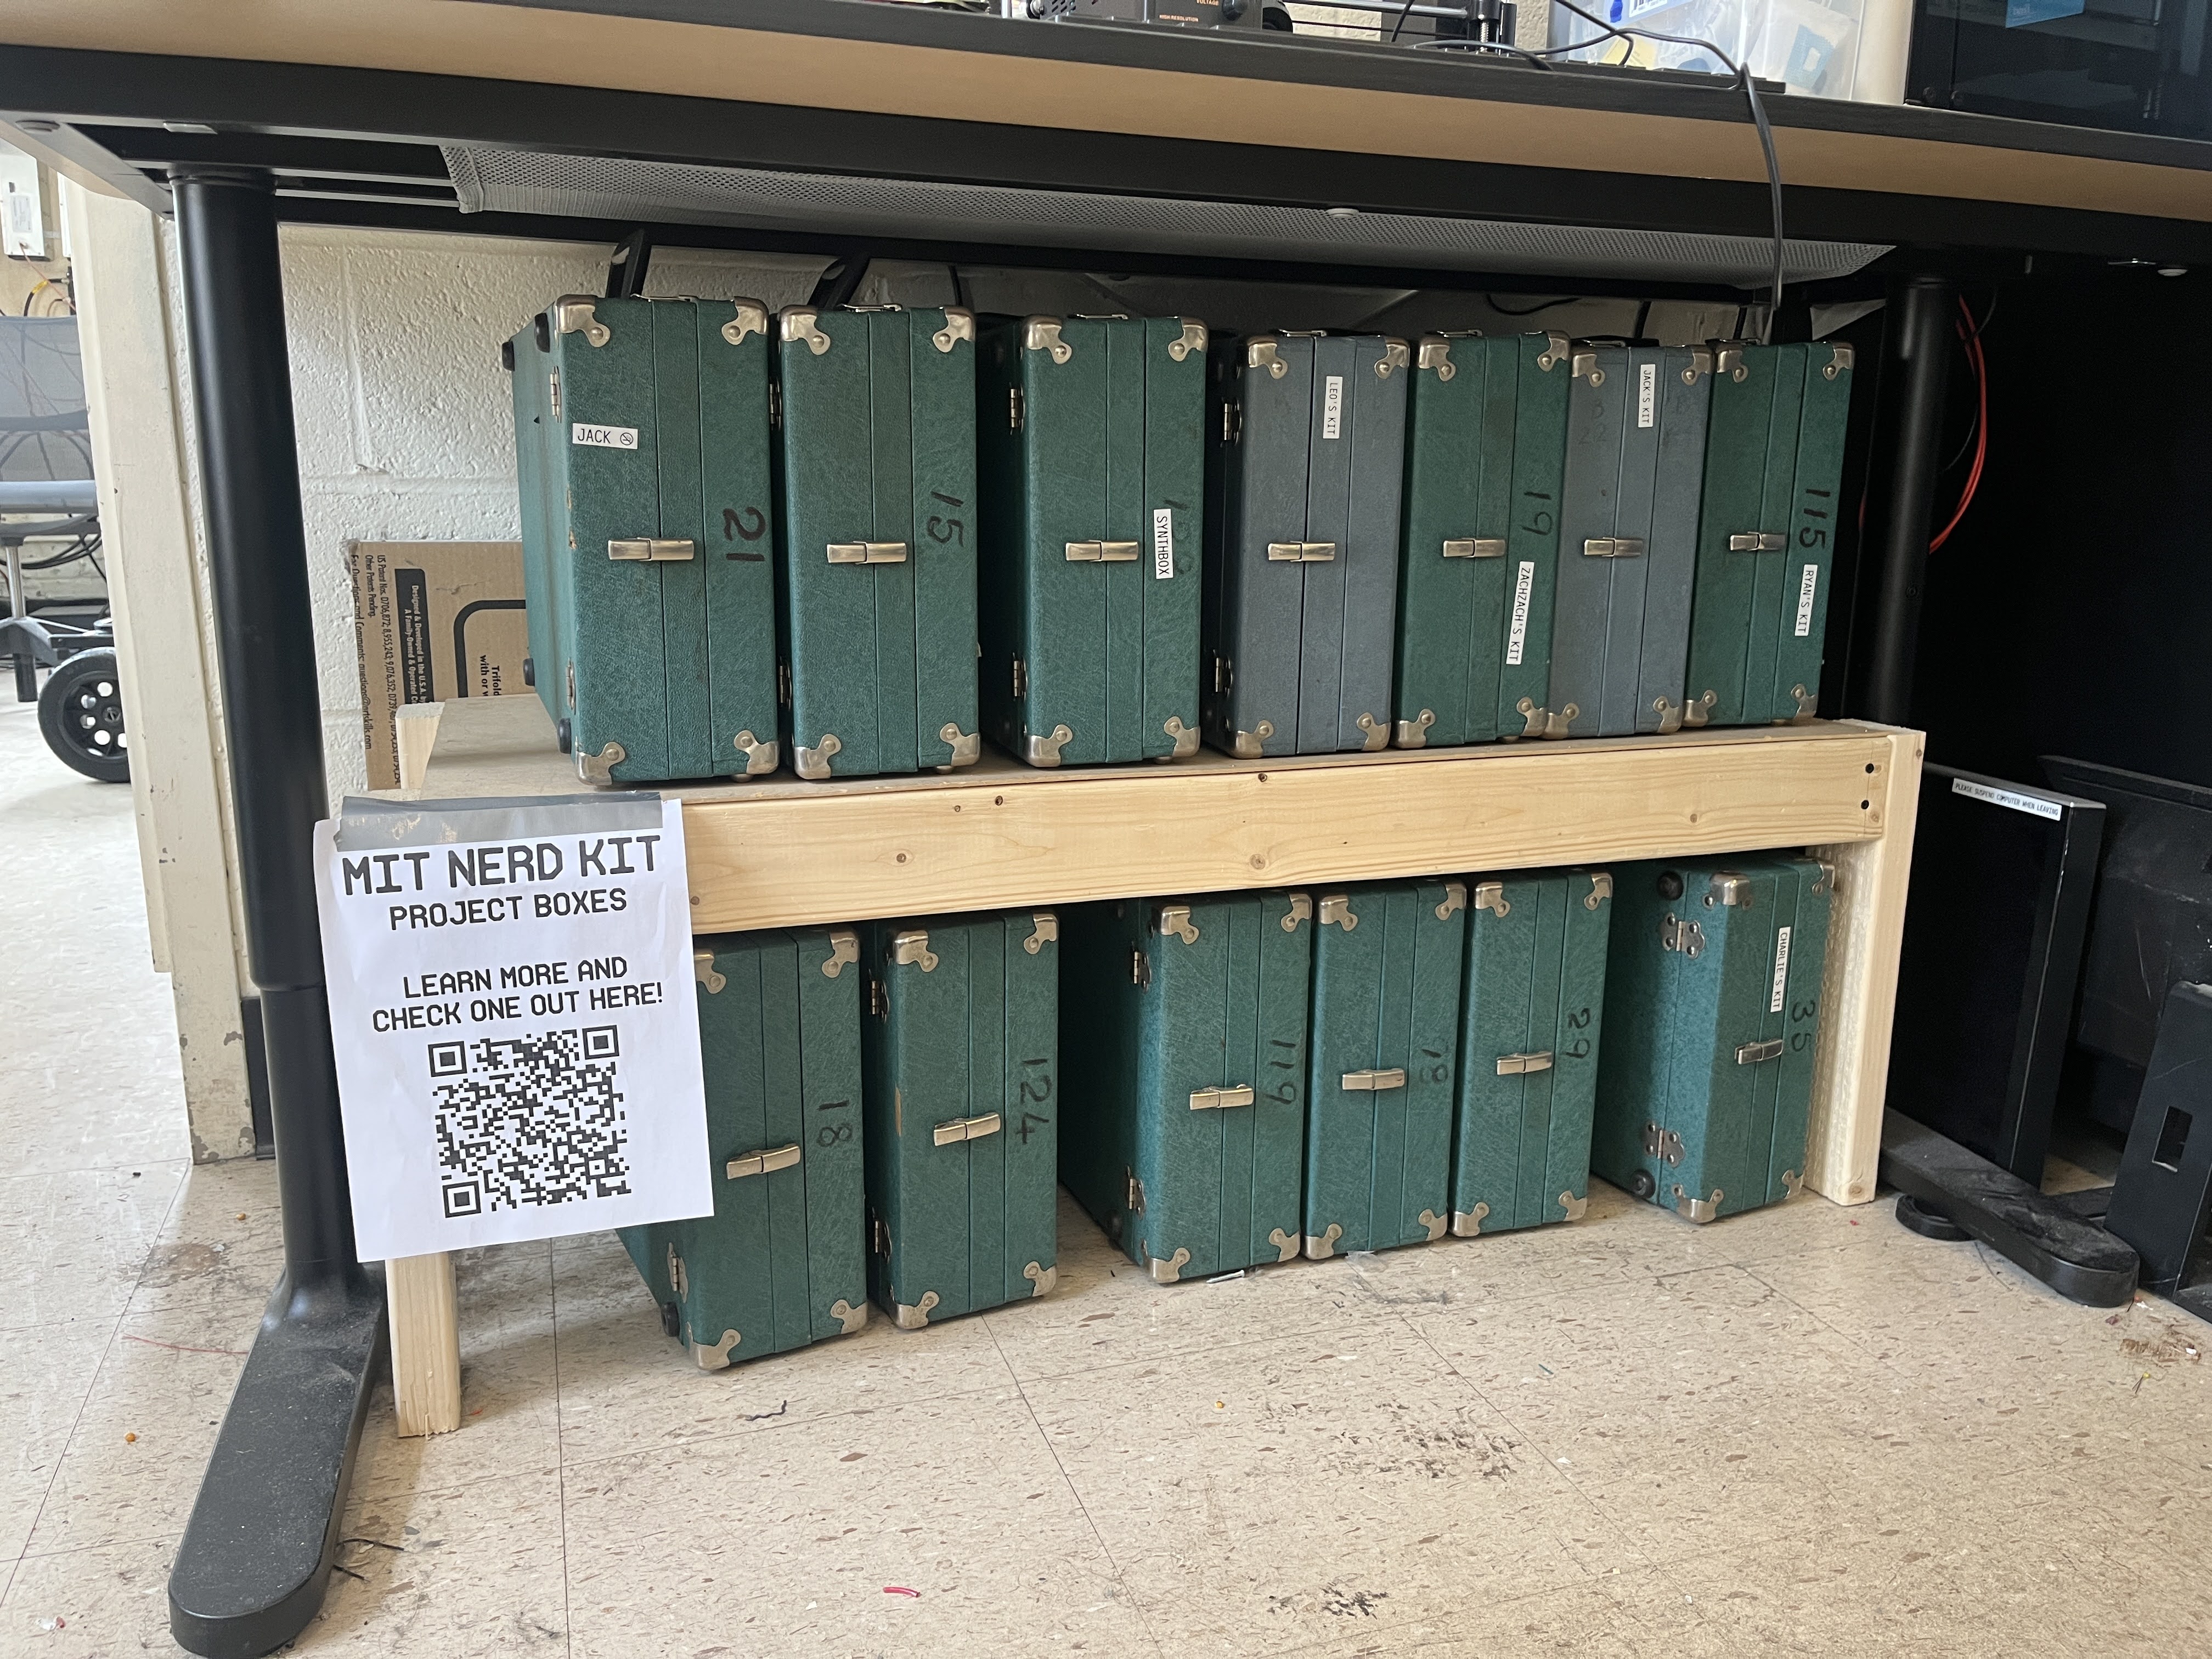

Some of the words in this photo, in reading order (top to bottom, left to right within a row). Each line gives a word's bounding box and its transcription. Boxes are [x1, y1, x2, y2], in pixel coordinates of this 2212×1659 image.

[1328, 382, 1339, 413] LEO'S
[1642, 370, 1652, 403] JACK'S
[1327, 416, 1336, 435] KIT
[1641, 407, 1650, 424] KIT
[577, 428, 611, 444] JACK
[723, 506, 766, 562] 21
[926, 490, 964, 548] 15
[1799, 488, 1831, 550] 115
[1156, 515, 1170, 576] SYNTHBOX
[365, 555, 374, 571] Other
[379, 565, 387, 582] Patent
[366, 572, 376, 592] Patents
[1801, 571, 1814, 608] RYAN'S
[355, 606, 364, 619] and
[368, 594, 378, 618] Pending.
[411, 585, 421, 614] Designed
[1511, 567, 1531, 635] ZACHZACH'S
[404, 616, 414, 658] Family-Owned
[414, 623, 423, 654] Developed
[1797, 613, 1808, 633] KIT
[480, 655, 489, 675] with
[1509, 640, 1520, 662] KIT
[408, 667, 417, 694] Operated
[482, 679, 488, 689] or
[492, 665, 501, 696] Trifold
[1955, 783, 1973, 792] PLEASE
[1974, 788, 1994, 799] SUSPEND
[1996, 794, 2020, 805] COMPUTER
[2022, 800, 2035, 809] WHEN
[2036, 804, 2058, 816] LEAVING
[342, 851, 430, 895] MIT
[448, 843, 563, 888] NERD
[579, 835, 661, 876] KIT
[390, 896, 522, 930] PROJECT
[535, 888, 628, 918] BOXES
[1775, 932, 1788, 986] CHARLIE'S
[403, 968, 490, 998] LEARN
[500, 962, 568, 988] MORE
[578, 956, 628, 981] AND
[373, 1002, 461, 1032] CHECK
[470, 996, 521, 1021] ONE
[530, 990, 579, 1016] OUT
[590, 983, 663, 1010] HERE!
[1773, 990, 1781, 1009] KIT
[1565, 1006, 1591, 1059] 29
[1792, 999, 1816, 1052] 35
[1268, 1039, 1297, 1104] 119
[1015, 1058, 1052, 1146] 124
[817, 1099, 853, 1148] 18
